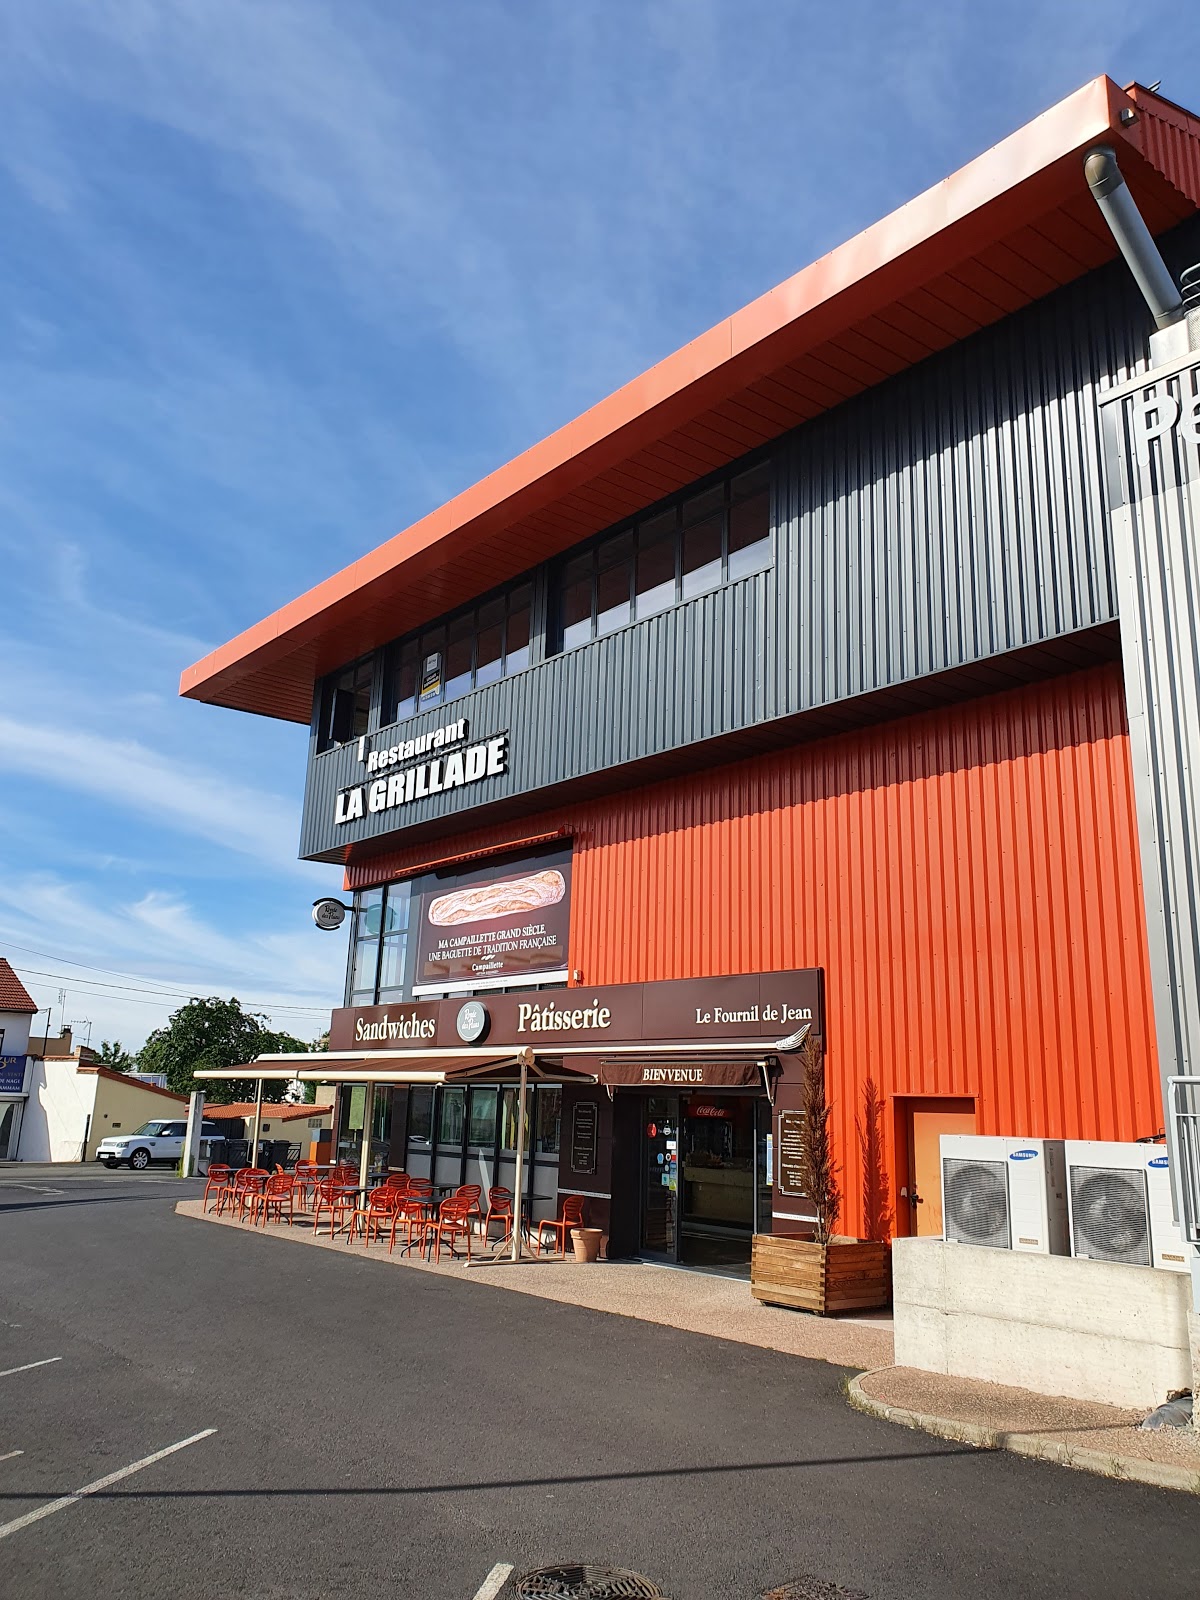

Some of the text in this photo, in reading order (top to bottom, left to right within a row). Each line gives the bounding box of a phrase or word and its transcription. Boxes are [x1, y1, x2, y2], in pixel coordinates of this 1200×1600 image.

[367, 718, 466, 773] Restaurant
[335, 737, 505, 824] LA GRILLADE
[428, 935, 557, 961] UNE BAGUETTE DE TRADITION FRANÇAISE
[438, 924, 546, 949] MA CAMPAILLETTE GRAND SIÈCLE,
[472, 961, 504, 972] Campaillette
[355, 1012, 435, 1041] Sandwiches
[517, 998, 611, 1033] Pâtisserie
[696, 1004, 812, 1024] Le Fournil de Jean
[642, 1068, 703, 1081] BIENVENUE
